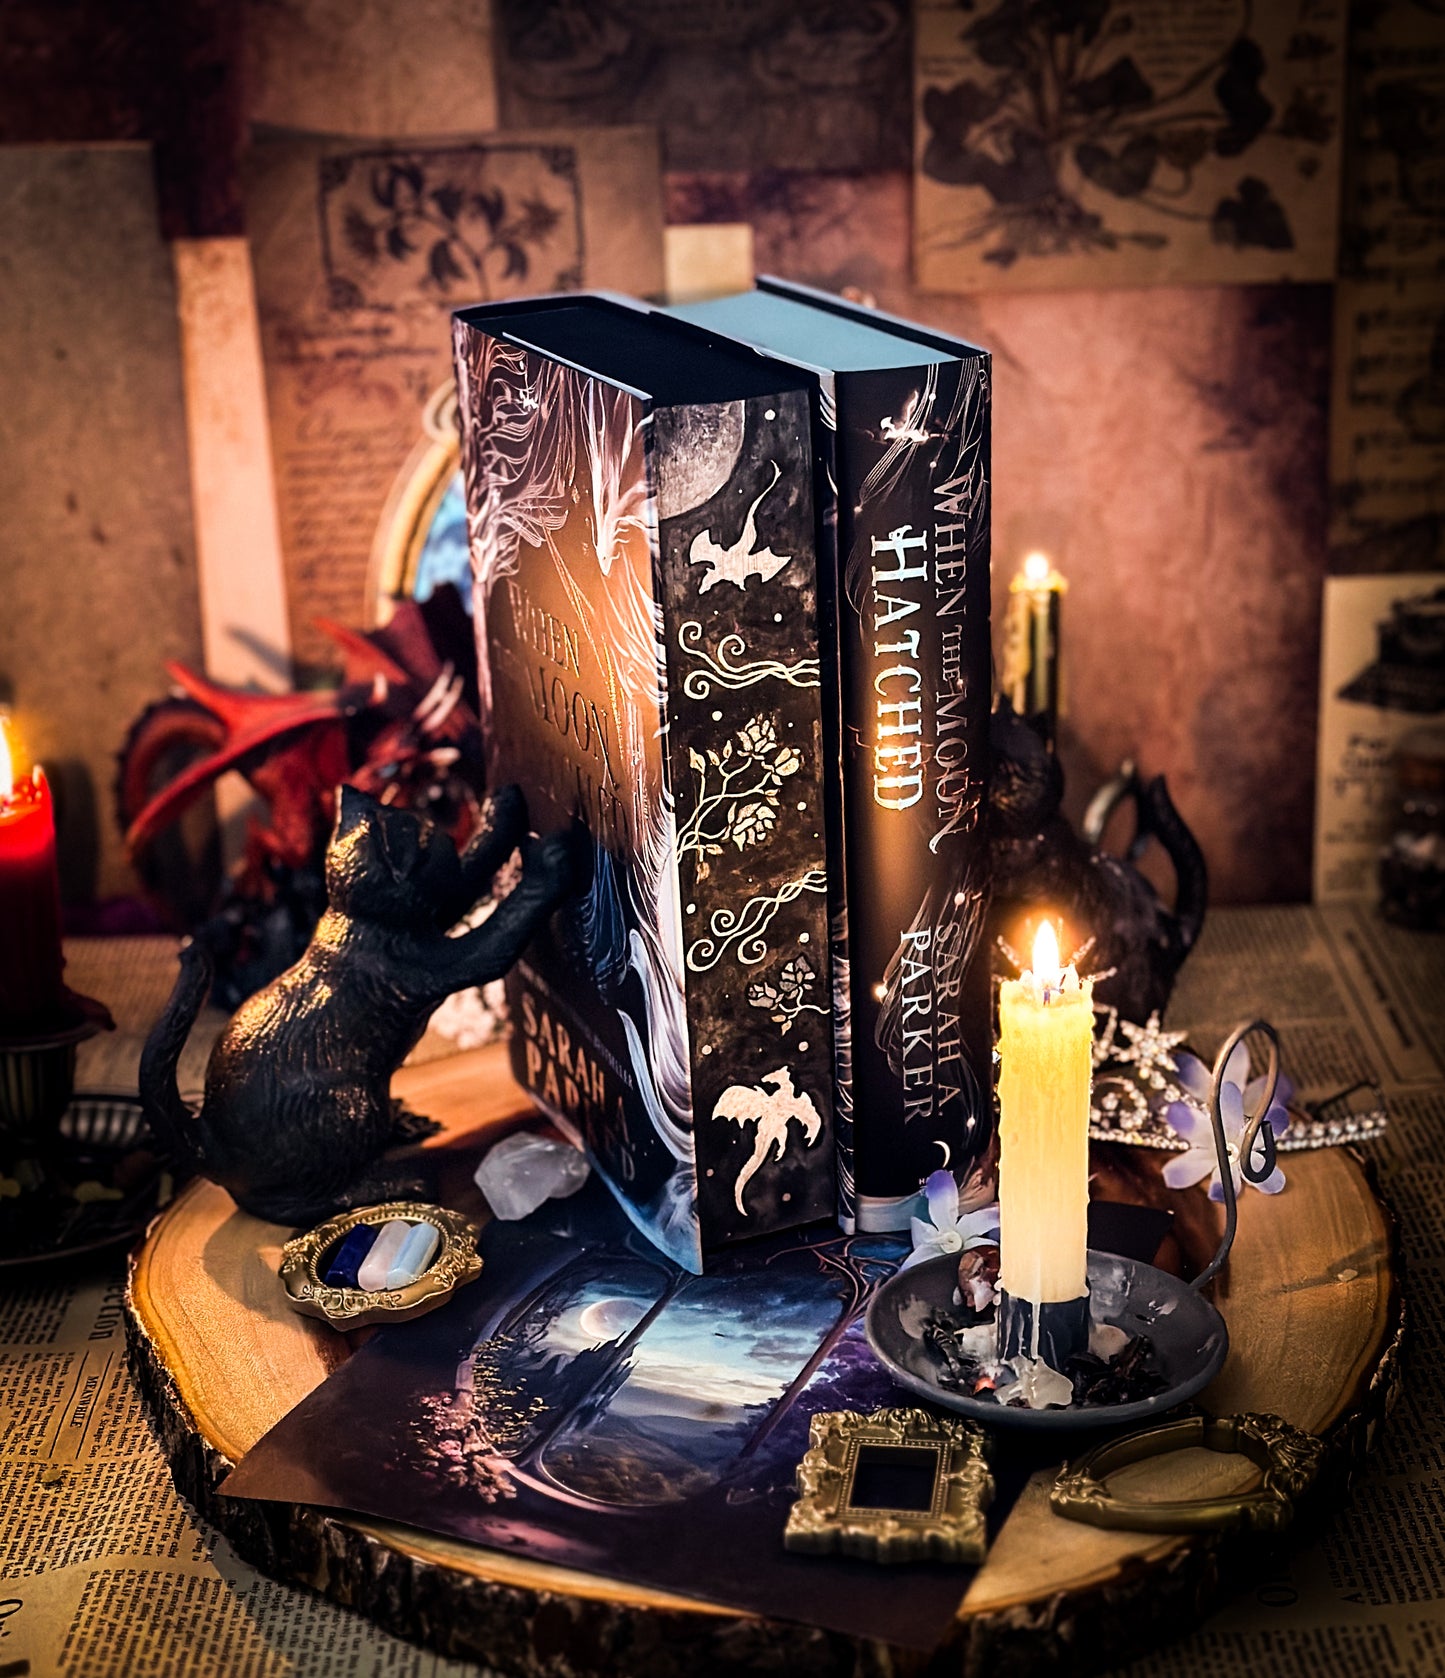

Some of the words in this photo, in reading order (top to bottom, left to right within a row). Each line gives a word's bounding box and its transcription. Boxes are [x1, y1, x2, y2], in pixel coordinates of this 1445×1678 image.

[933, 470, 972, 617] WHEN
[506, 577, 580, 678] WHEN
[870, 524, 928, 811] HATCHED
[941, 625, 964, 686] THE
[929, 687, 970, 853] MOON
[521, 991, 605, 1112] SARAH
[900, 926, 932, 1125] PARKER
[935, 923, 961, 1064] SARAH
[70, 1375, 99, 1428] MEANWHILE
